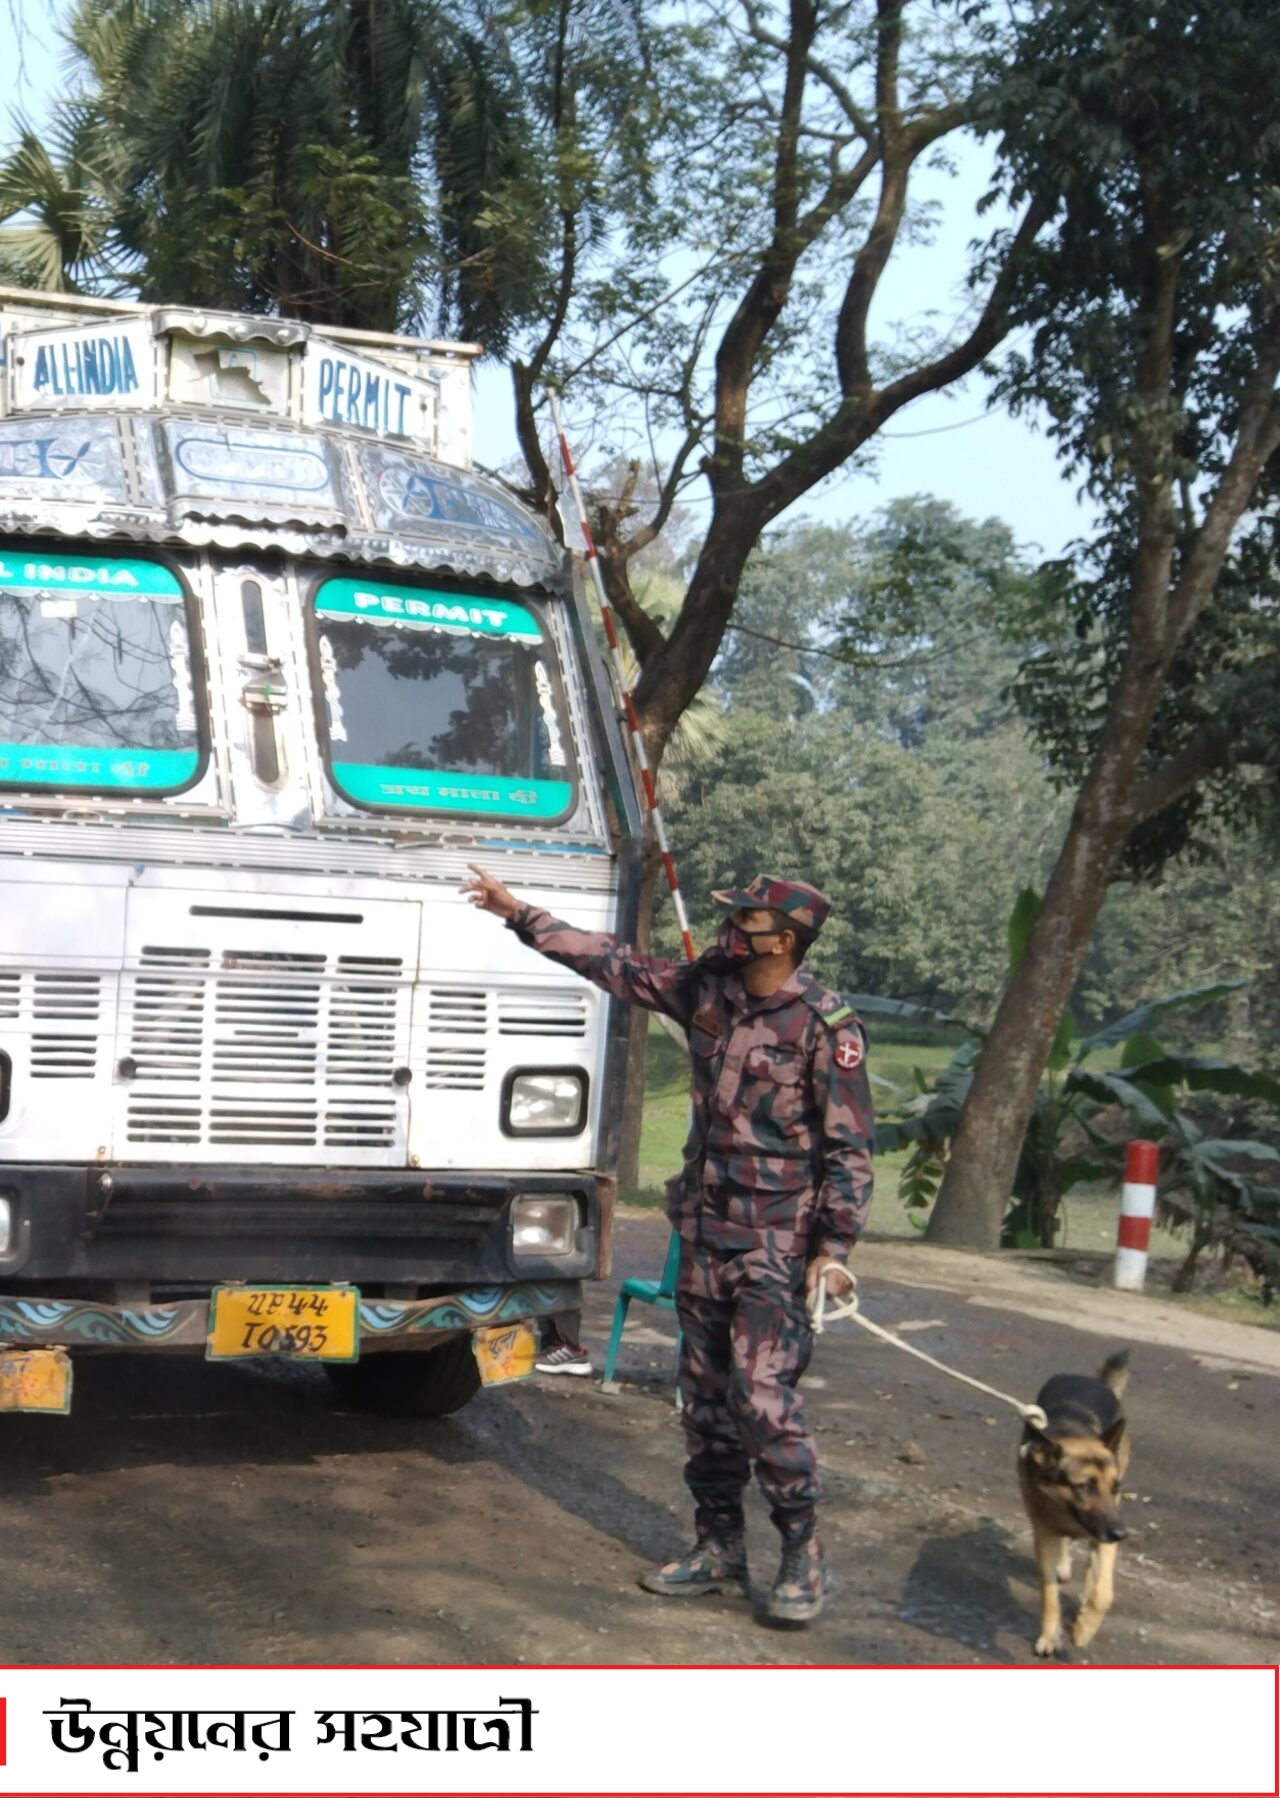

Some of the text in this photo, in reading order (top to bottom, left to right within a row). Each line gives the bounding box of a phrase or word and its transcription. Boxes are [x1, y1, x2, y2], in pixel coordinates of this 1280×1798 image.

[318, 358, 412, 436] PERMIT
[24, 563, 139, 587] INDIA
[353, 592, 509, 627] PERMIT
